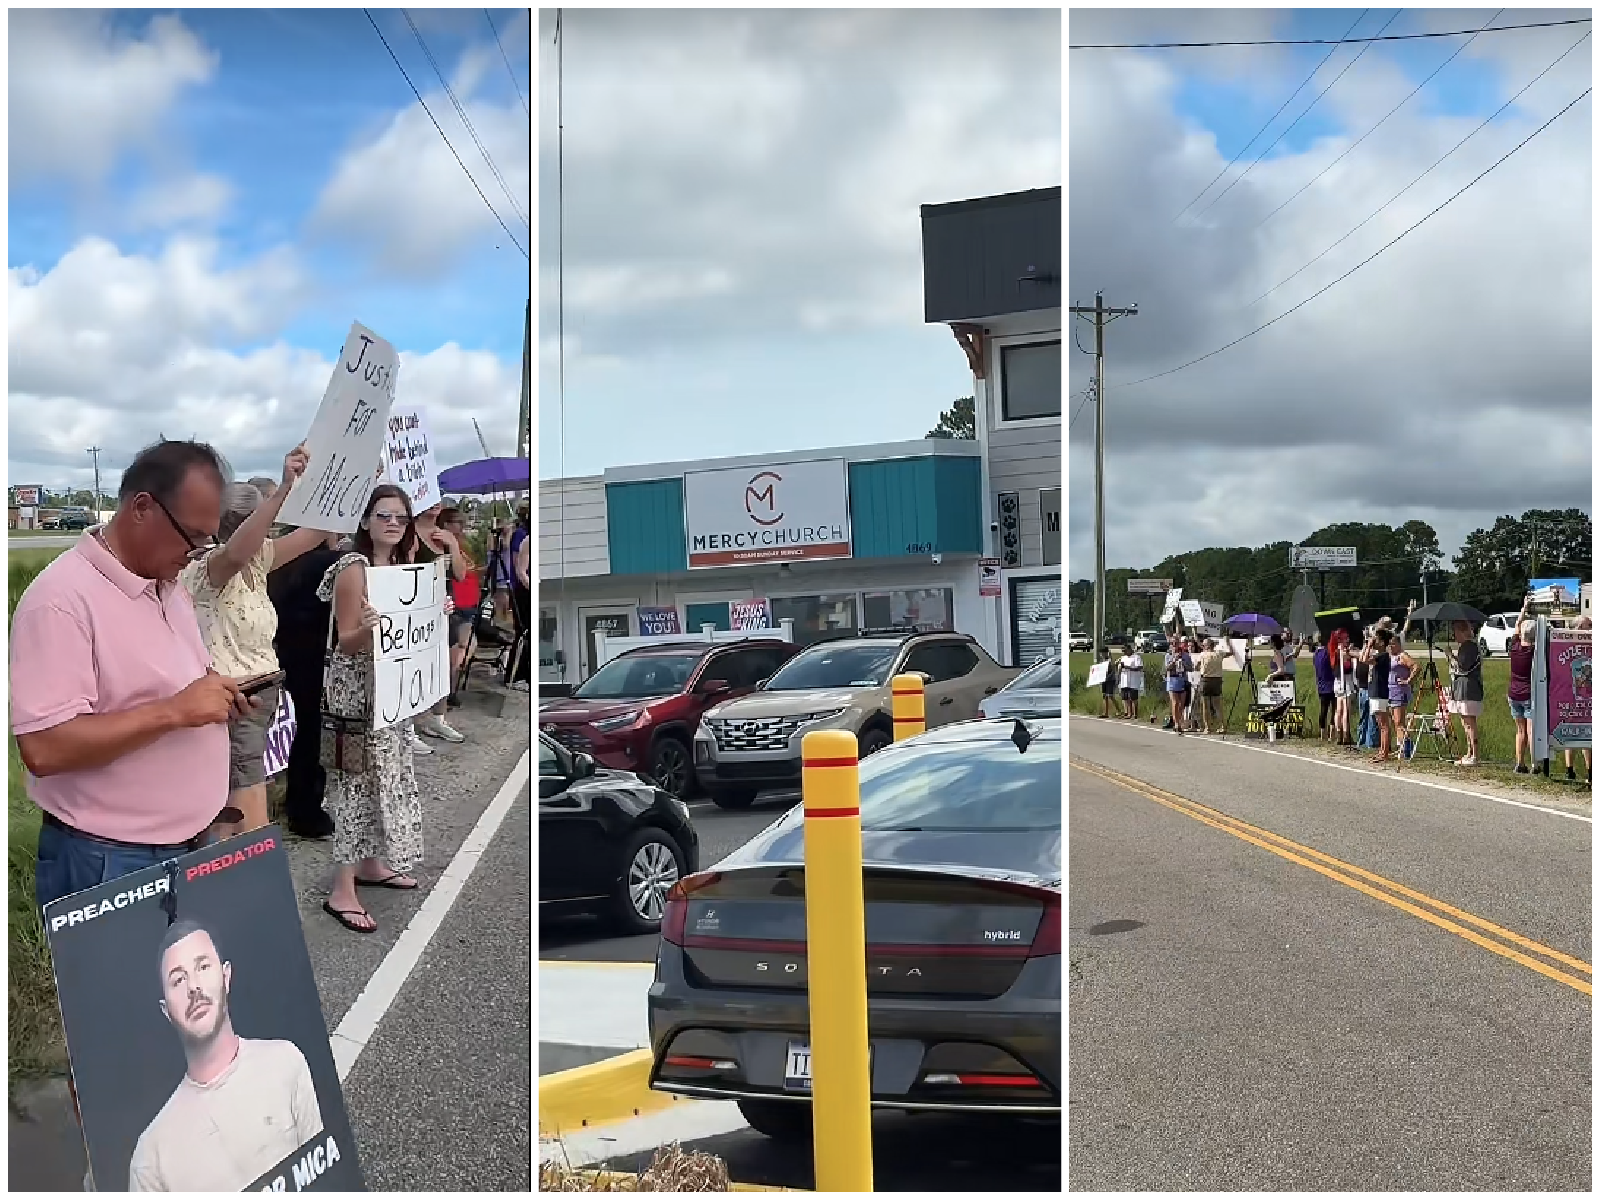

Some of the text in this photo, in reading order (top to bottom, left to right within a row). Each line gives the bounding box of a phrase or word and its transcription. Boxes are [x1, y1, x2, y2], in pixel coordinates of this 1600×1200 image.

[51, 838, 276, 932] PREACHER PREDATOR
[984, 930, 1021, 941] hybrid
[756, 961, 922, 977] SOTA
[292, 1135, 341, 1192] MICA
